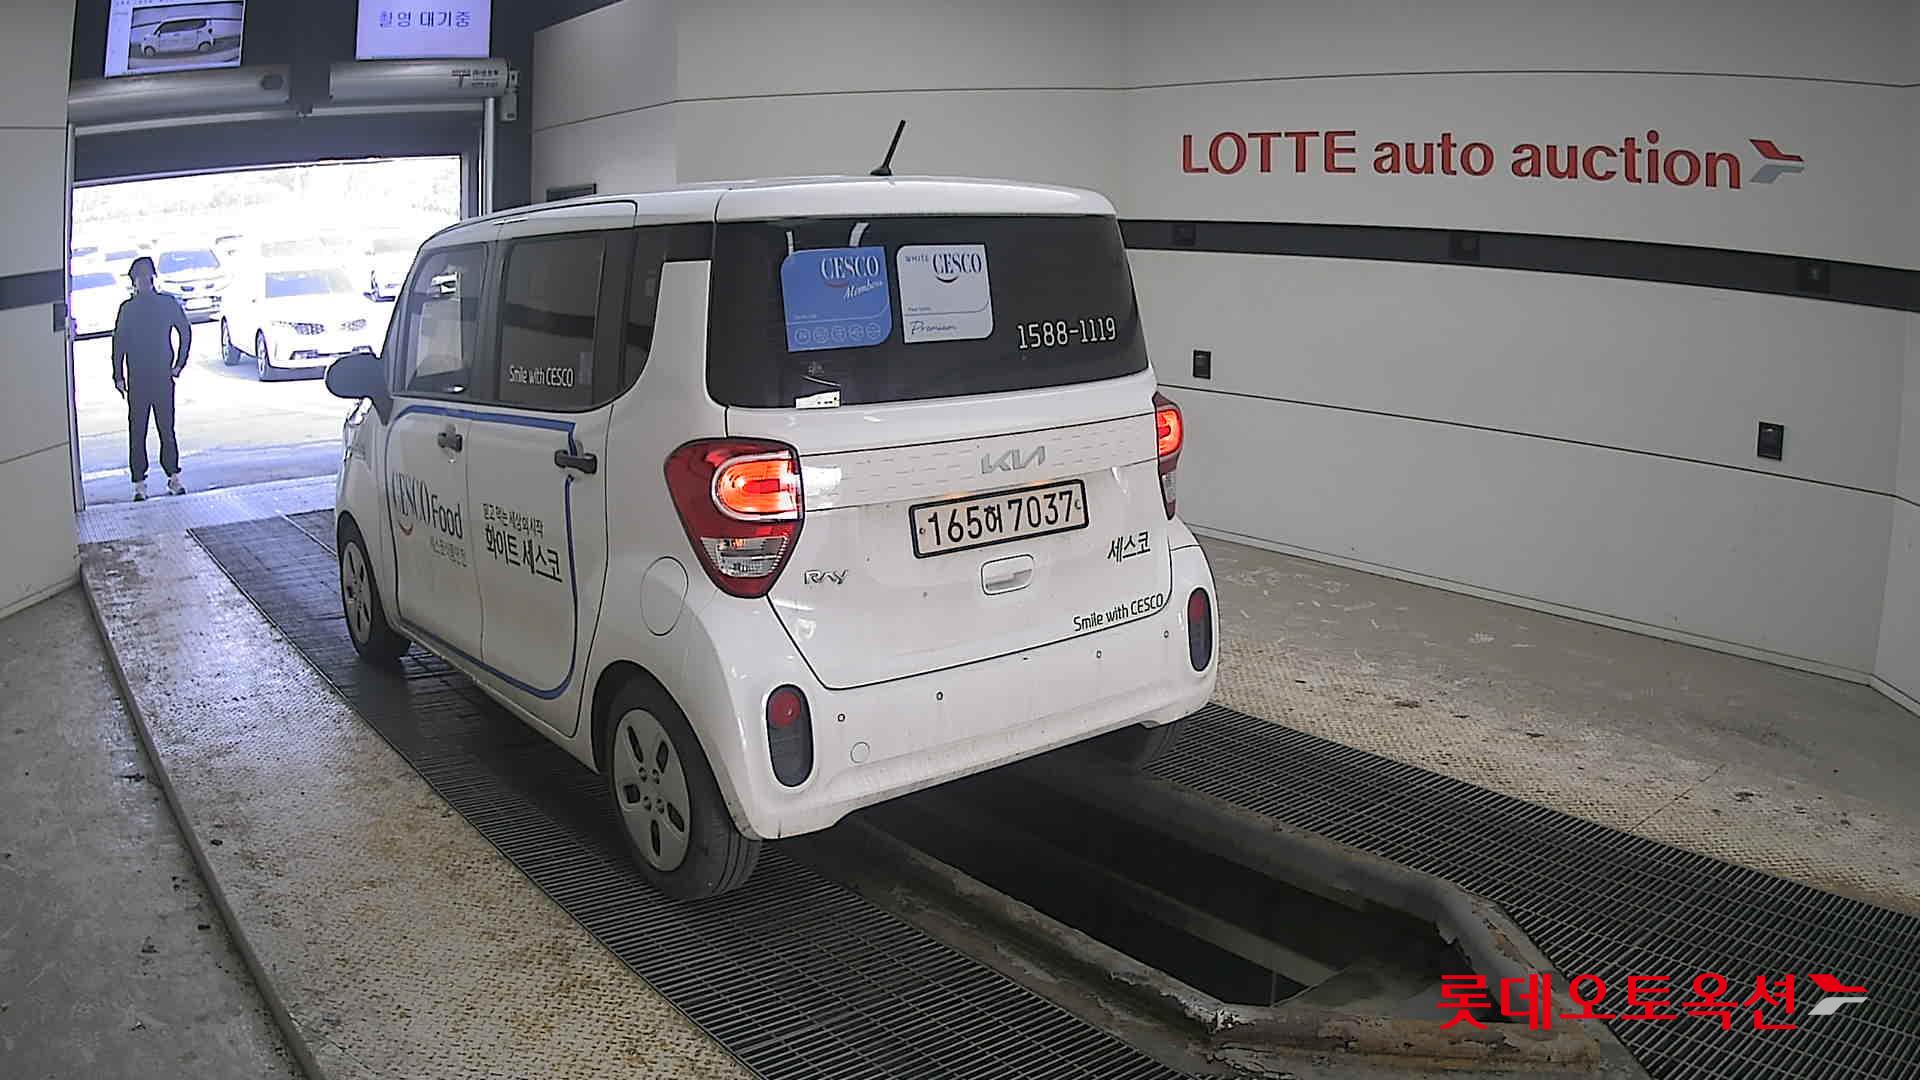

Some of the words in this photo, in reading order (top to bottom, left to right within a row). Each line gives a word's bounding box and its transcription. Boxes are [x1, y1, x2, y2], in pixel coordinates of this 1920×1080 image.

[420, 10, 472, 28] 대기중
[1181, 130, 1357, 175] LOTTE
[1373, 132, 1495, 177] auto
[1511, 130, 1742, 189] auction
[820, 255, 880, 280] CESCO
[932, 253, 982, 275] CESCO
[1017, 317, 1117, 349] 1588-1119
[509, 364, 528, 384] Smile
[529, 366, 545, 385] with
[545, 367, 574, 387] CESCO
[392, 471, 430, 525] CESCO
[431, 494, 463, 539] Food
[1007, 490, 1074, 532] 7037
[484, 523, 521, 567] 화이트
[522, 539, 563, 583] 세스코
[1107, 531, 1151, 562] 세스코
[1073, 611, 1104, 632] Smile
[1105, 603, 1129, 623] with
[1130, 592, 1164, 616] CESCO
